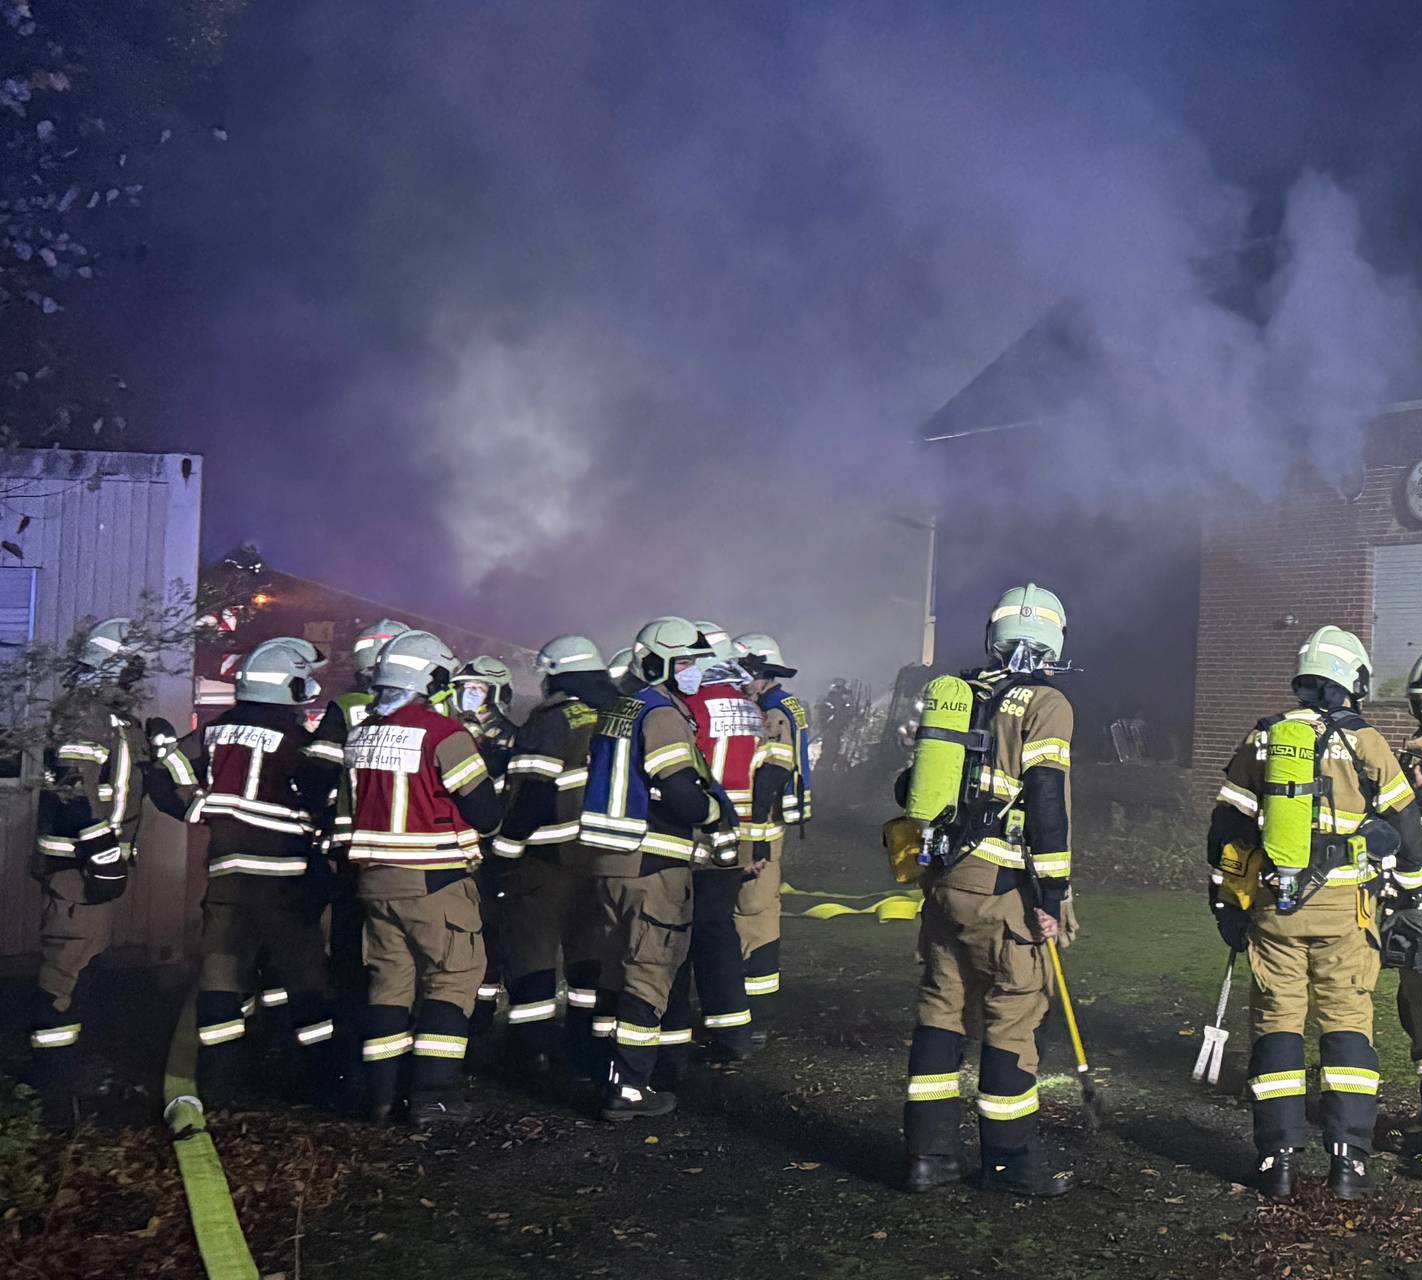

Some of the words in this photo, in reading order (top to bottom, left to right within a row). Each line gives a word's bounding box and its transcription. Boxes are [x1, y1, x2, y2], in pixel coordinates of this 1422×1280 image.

[941, 701, 968, 713] AUER
[1000, 700, 1025, 717] See
[1269, 745, 1295, 757] MSA
